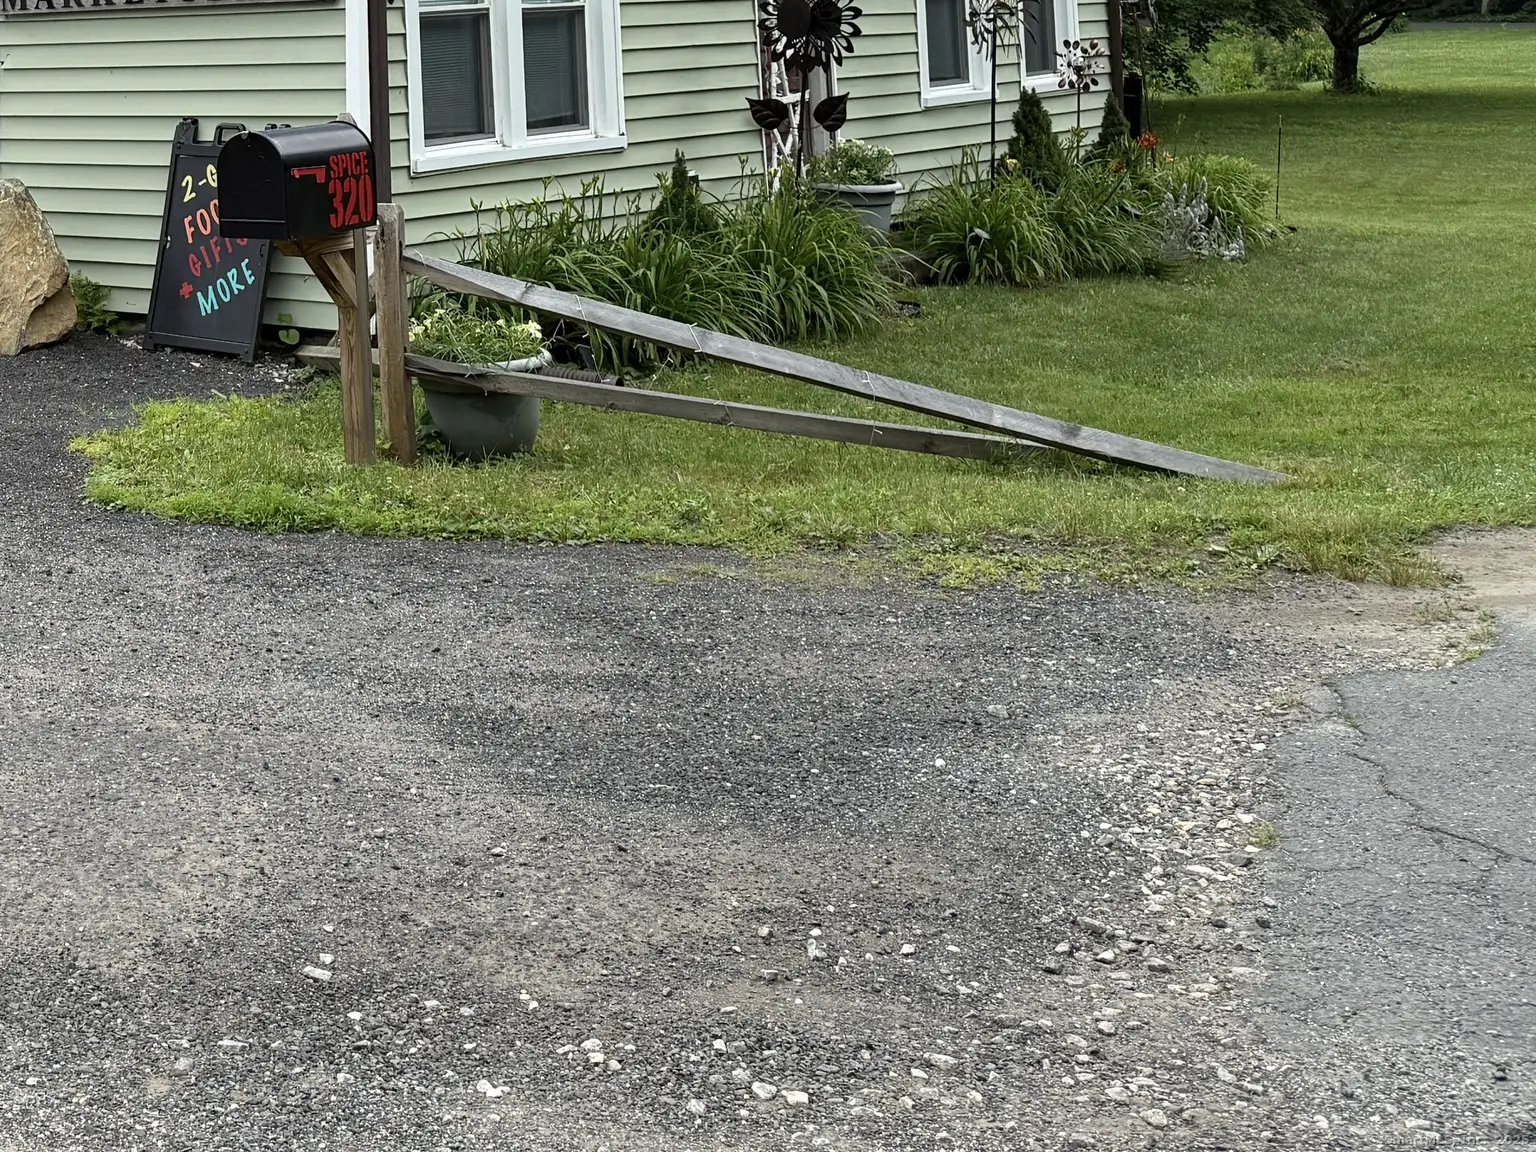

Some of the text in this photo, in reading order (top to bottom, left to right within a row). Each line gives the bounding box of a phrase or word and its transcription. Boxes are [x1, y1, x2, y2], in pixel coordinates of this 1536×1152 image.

[181, 163, 218, 203] 2-G
[328, 151, 368, 179] SPICE
[328, 174, 373, 228] 320
[196, 258, 256, 317] MORE
